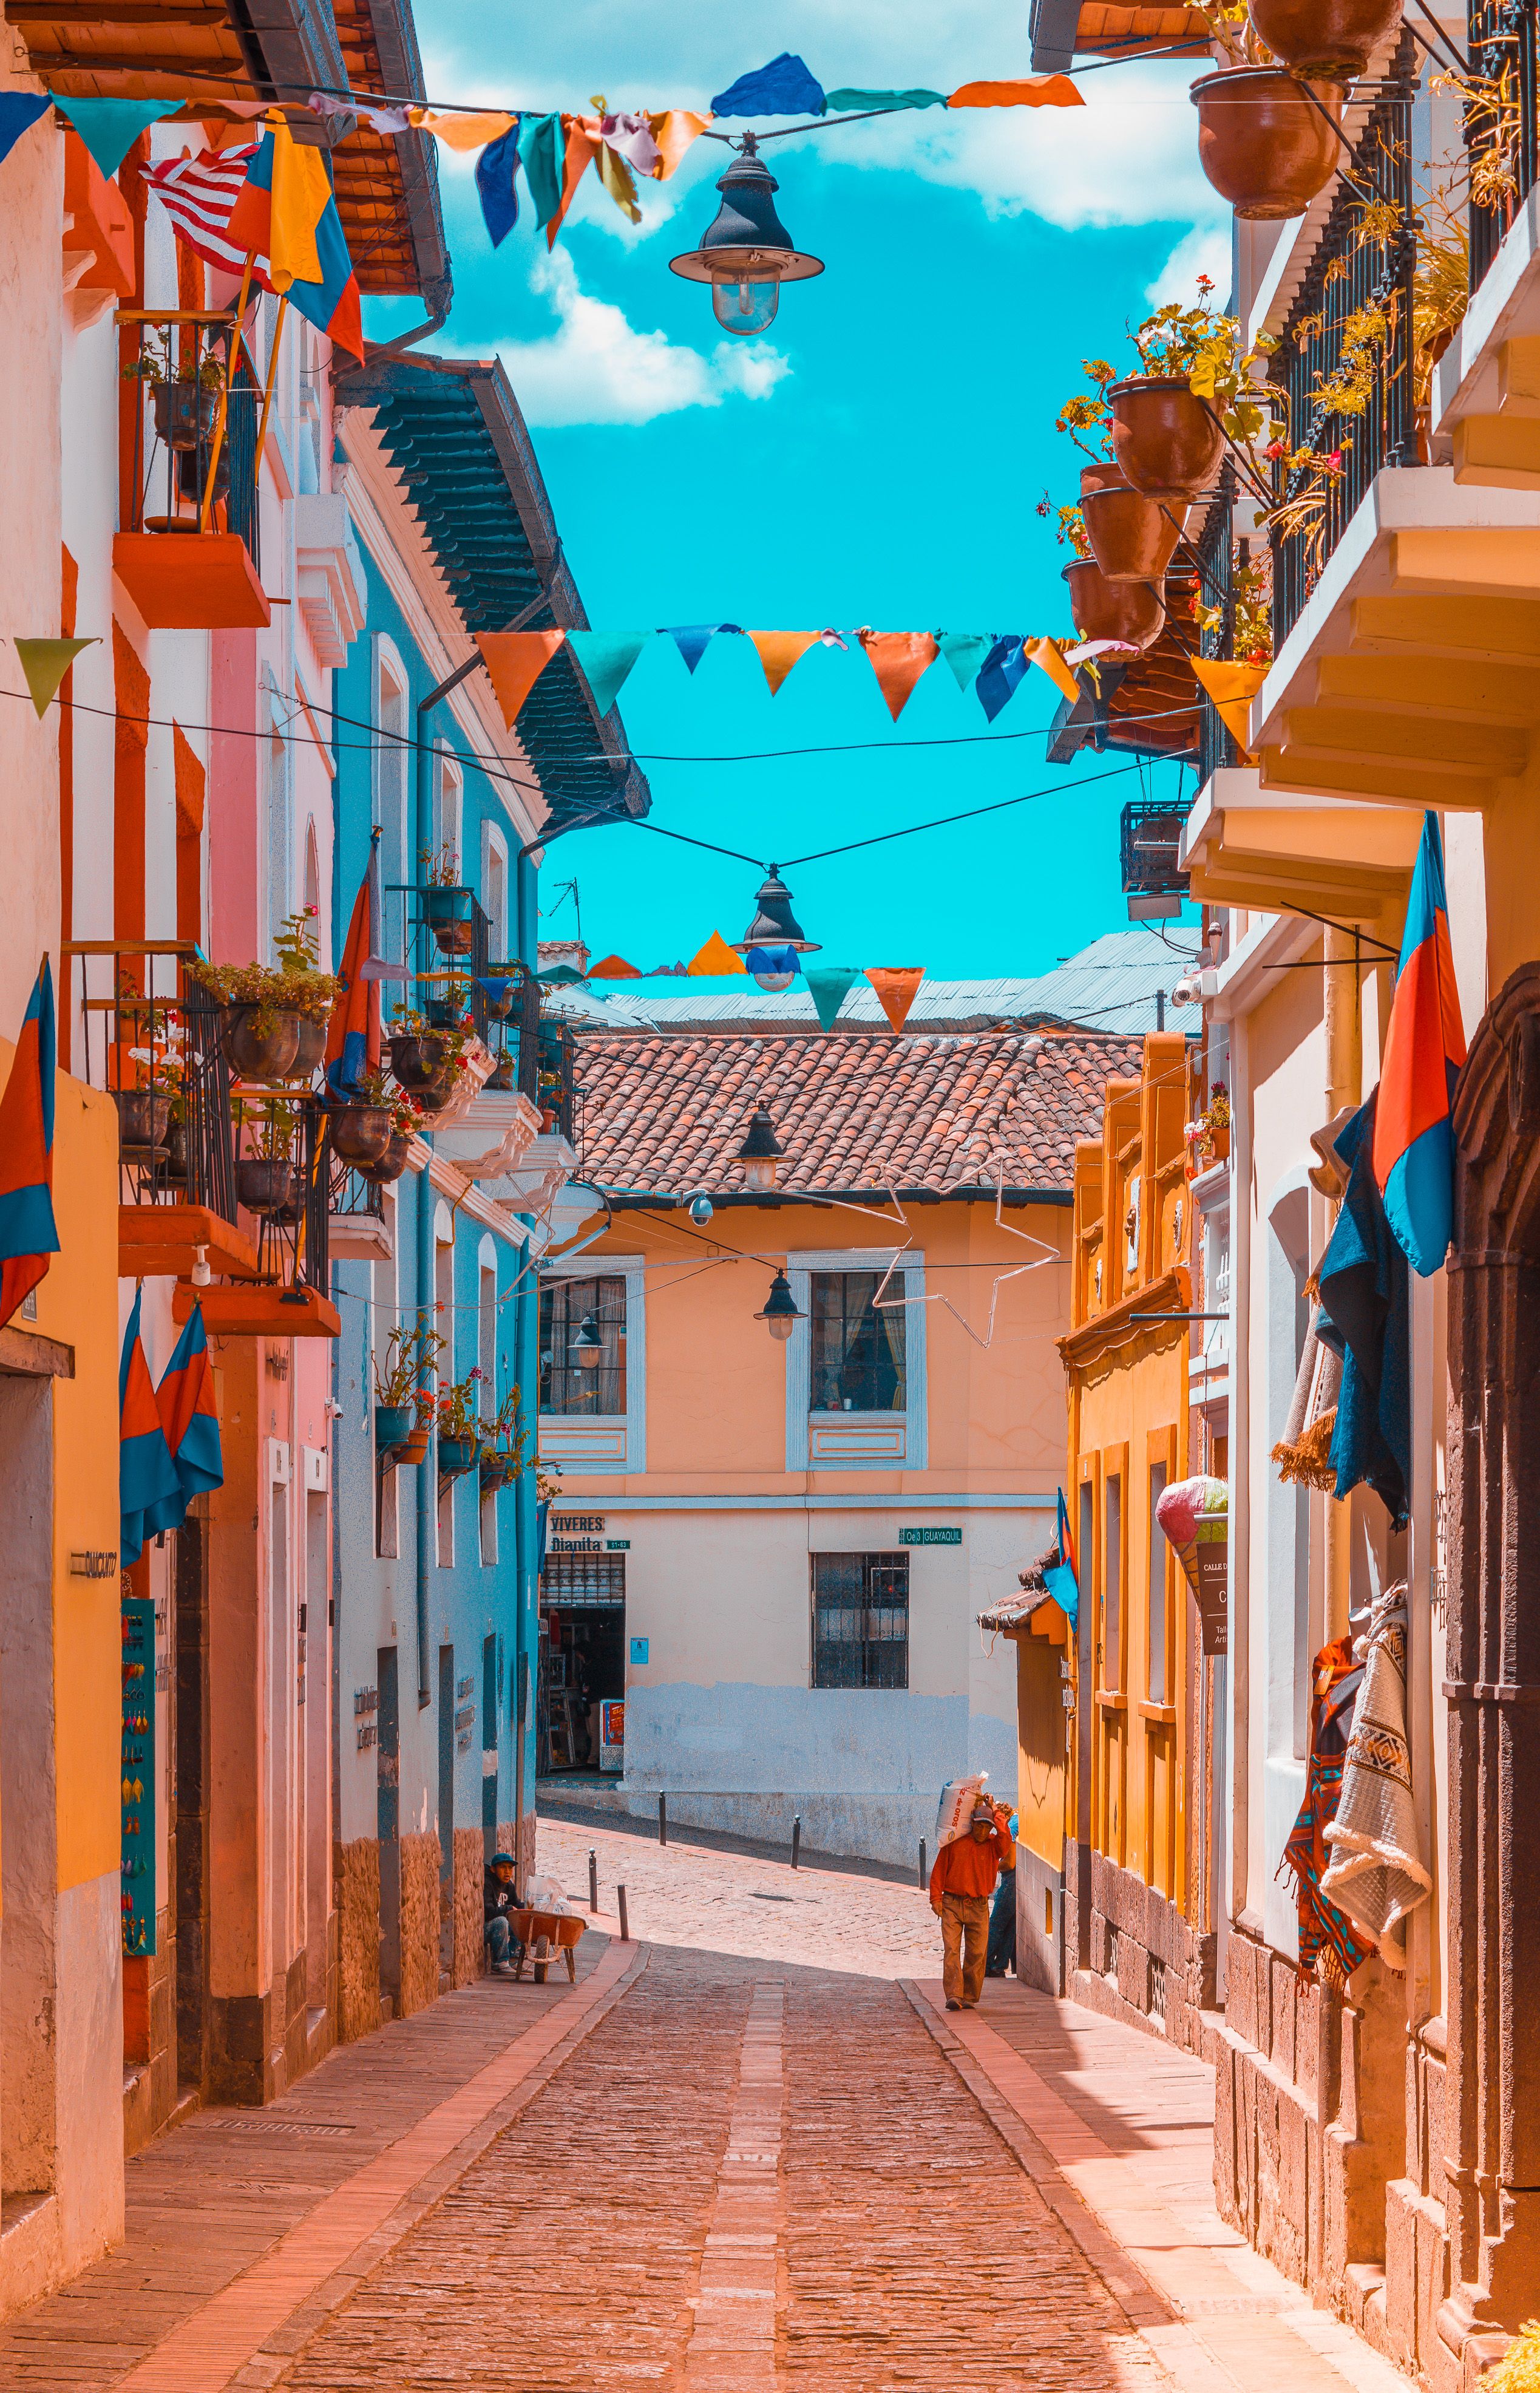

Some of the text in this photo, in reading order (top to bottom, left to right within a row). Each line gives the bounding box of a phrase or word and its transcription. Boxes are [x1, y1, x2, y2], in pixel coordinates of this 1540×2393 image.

[551, 1517, 603, 1531] VIVERES
[906, 1531, 920, 1541] Oe 3
[924, 1531, 960, 1541] GUAYAQUIL
[551, 1537, 602, 1552] Dianita
[1204, 1563, 1223, 1571] CALLE
